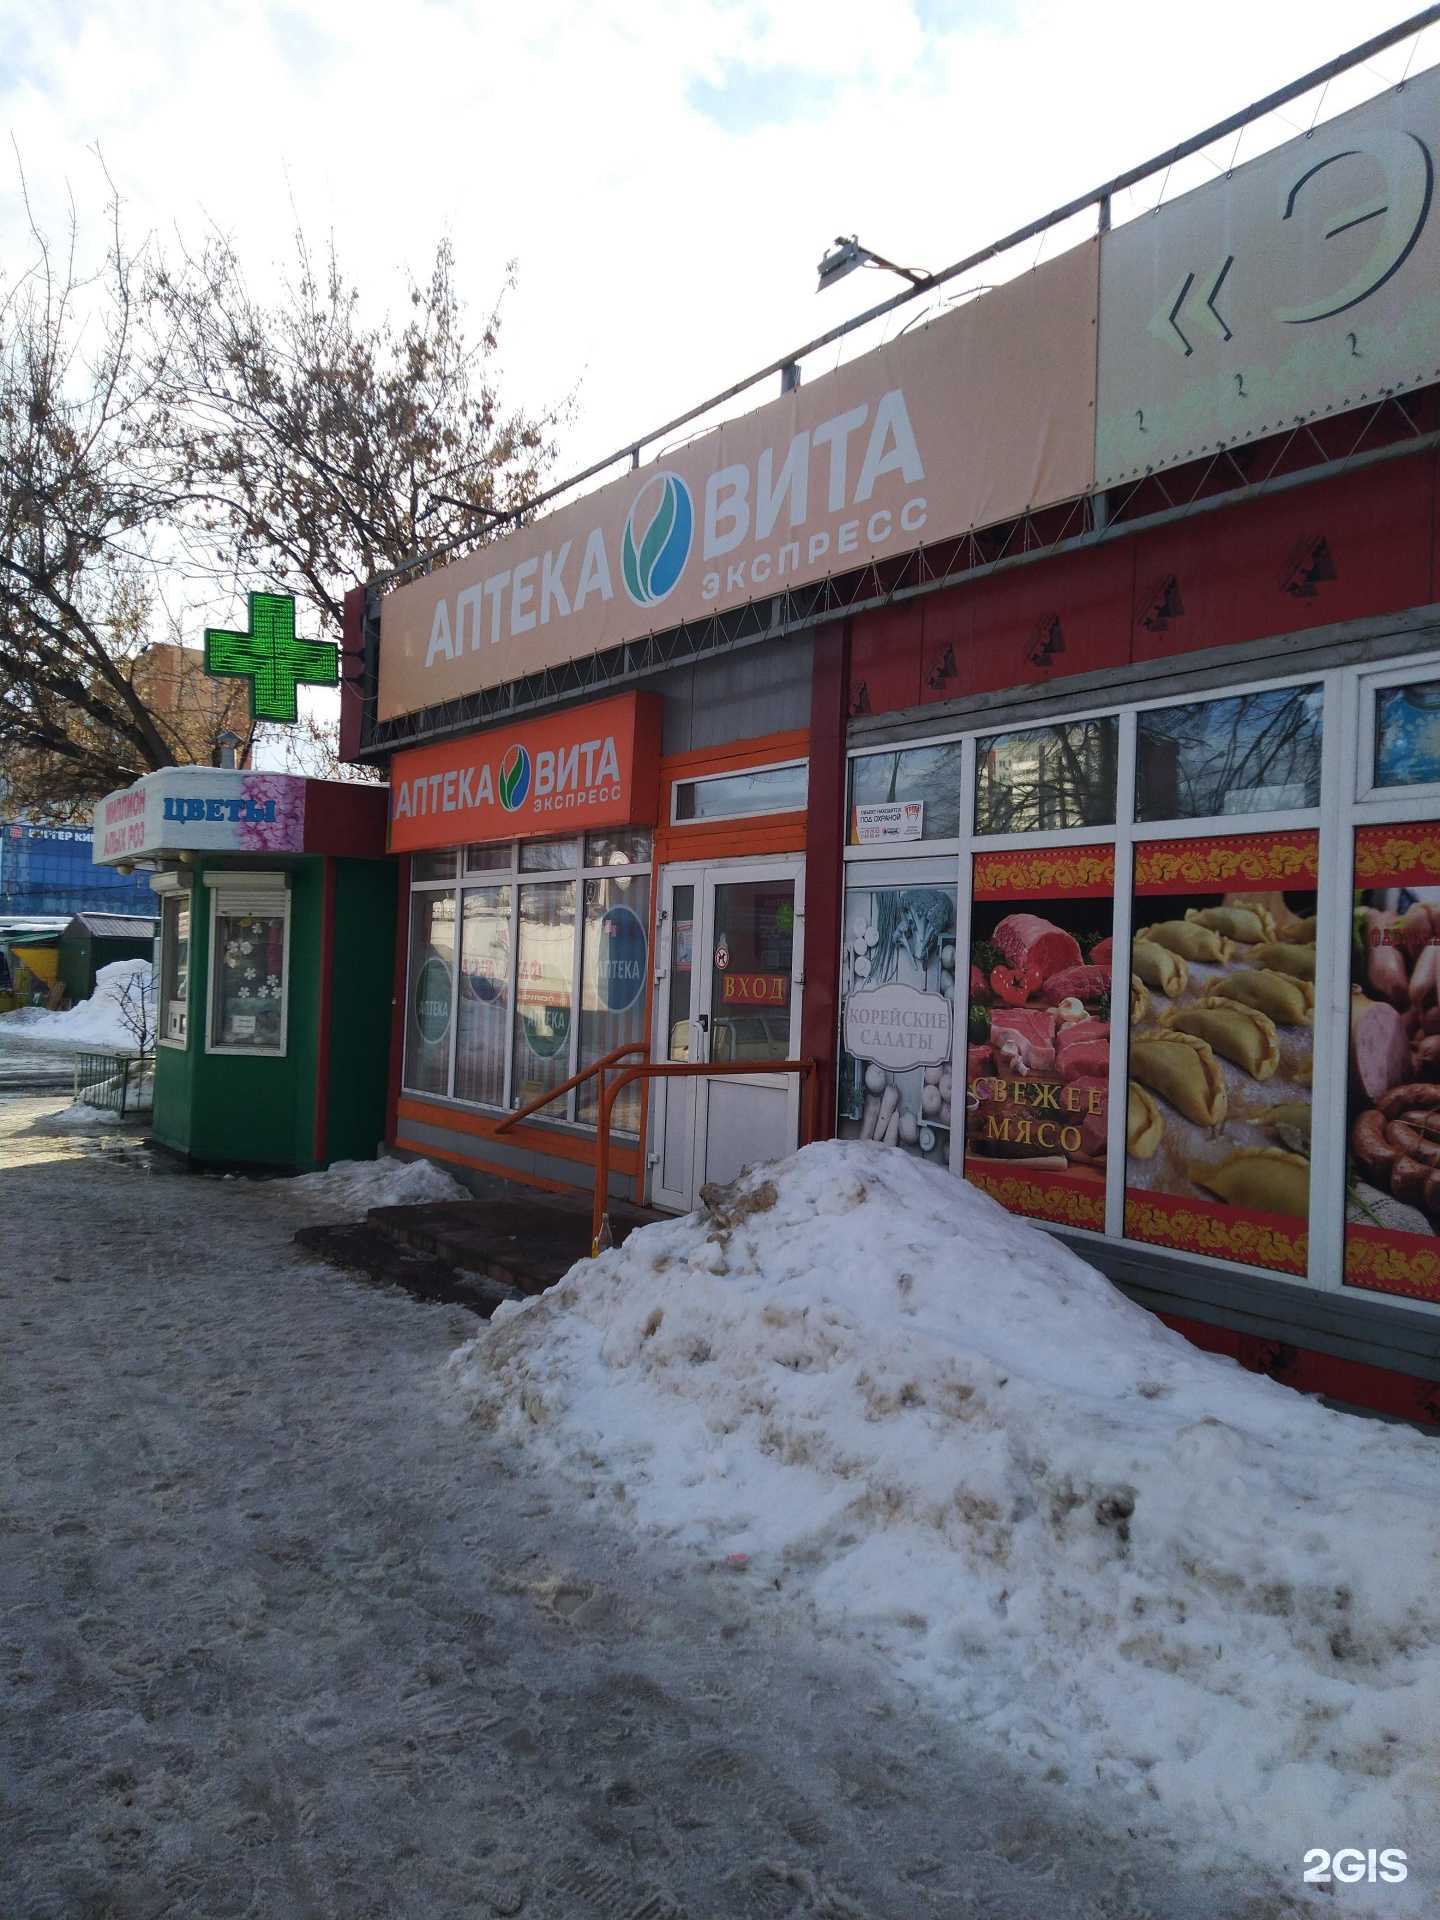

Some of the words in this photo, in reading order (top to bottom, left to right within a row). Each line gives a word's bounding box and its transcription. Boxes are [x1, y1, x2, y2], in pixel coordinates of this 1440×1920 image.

[424, 527, 614, 667] АПТЕКА
[702, 388, 926, 561] ВИТА
[702, 497, 930, 600] ЭКСПРЕСС
[393, 764, 495, 820] АПТЕКА
[534, 736, 620, 796] ВИТА
[163, 797, 277, 824] ЦВЕТЫ
[533, 785, 622, 813] ЭКСПРЕСС
[724, 975, 784, 1000] ВХОД
[848, 1008, 948, 1029] КОРЕЙСКИЕ
[861, 1029, 933, 1050] САЛАТЫ
[971, 1076, 1106, 1115] СВЕЖЕЕ
[986, 1115, 1082, 1152] МЯСО
